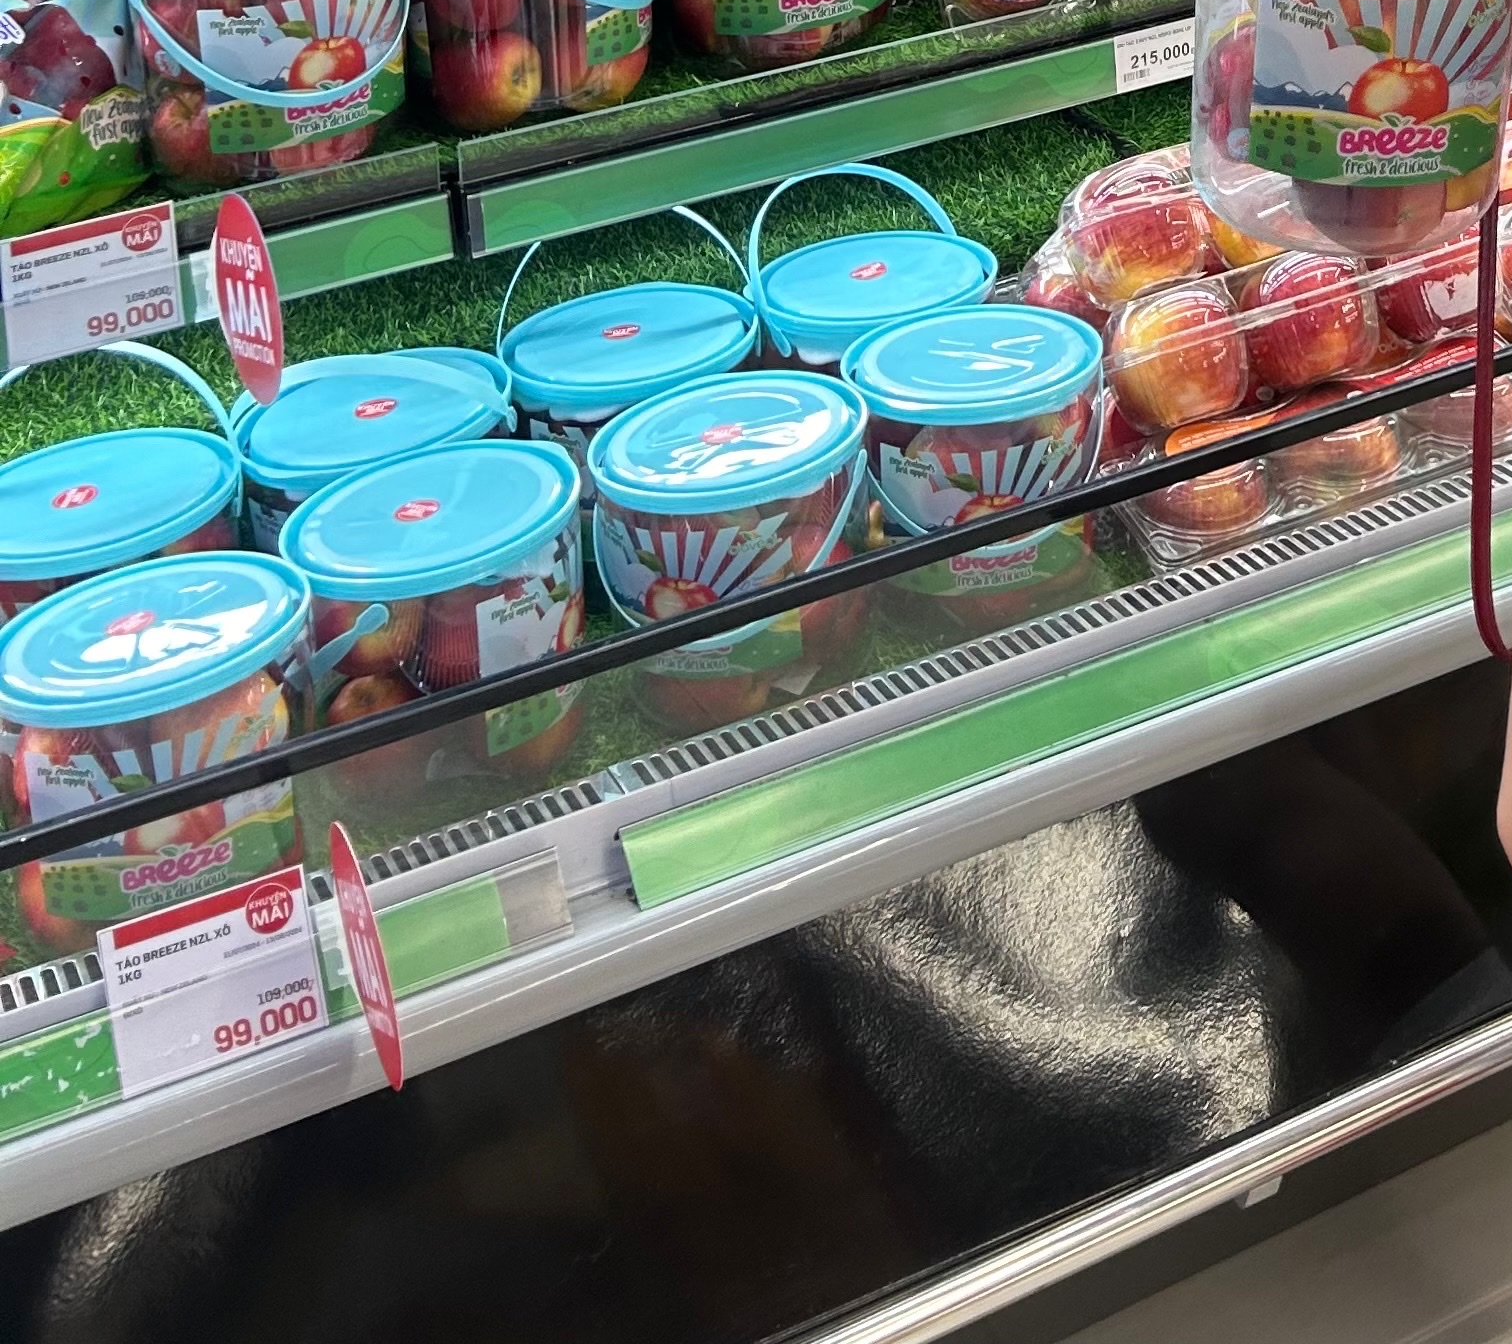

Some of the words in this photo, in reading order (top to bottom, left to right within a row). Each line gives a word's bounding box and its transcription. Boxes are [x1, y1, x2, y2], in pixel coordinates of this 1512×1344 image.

[787, 8, 810, 25] fresh
[818, 2, 852, 17] delicious
[295, 121, 320, 136] fresh
[330, 105, 368, 126] delicious
[1344, 158, 1377, 176] fresh
[1389, 156, 1439, 175] delicious
[127, 229, 158, 246] MÃI
[220, 235, 262, 273] KHUYẾN
[87, 298, 174, 337] 99,000
[226, 269, 271, 342] MÃI
[131, 891, 164, 910] fresh
[174, 868, 226, 898] delicious
[252, 900, 290, 929] MÃI
[116, 954, 141, 972] TÁO
[143, 940, 188, 963] BREEZE
[189, 934, 212, 947] NZL
[214, 923, 231, 940] XÔ
[118, 969, 142, 985] 1KG
[214, 996, 317, 1053] 99,000
